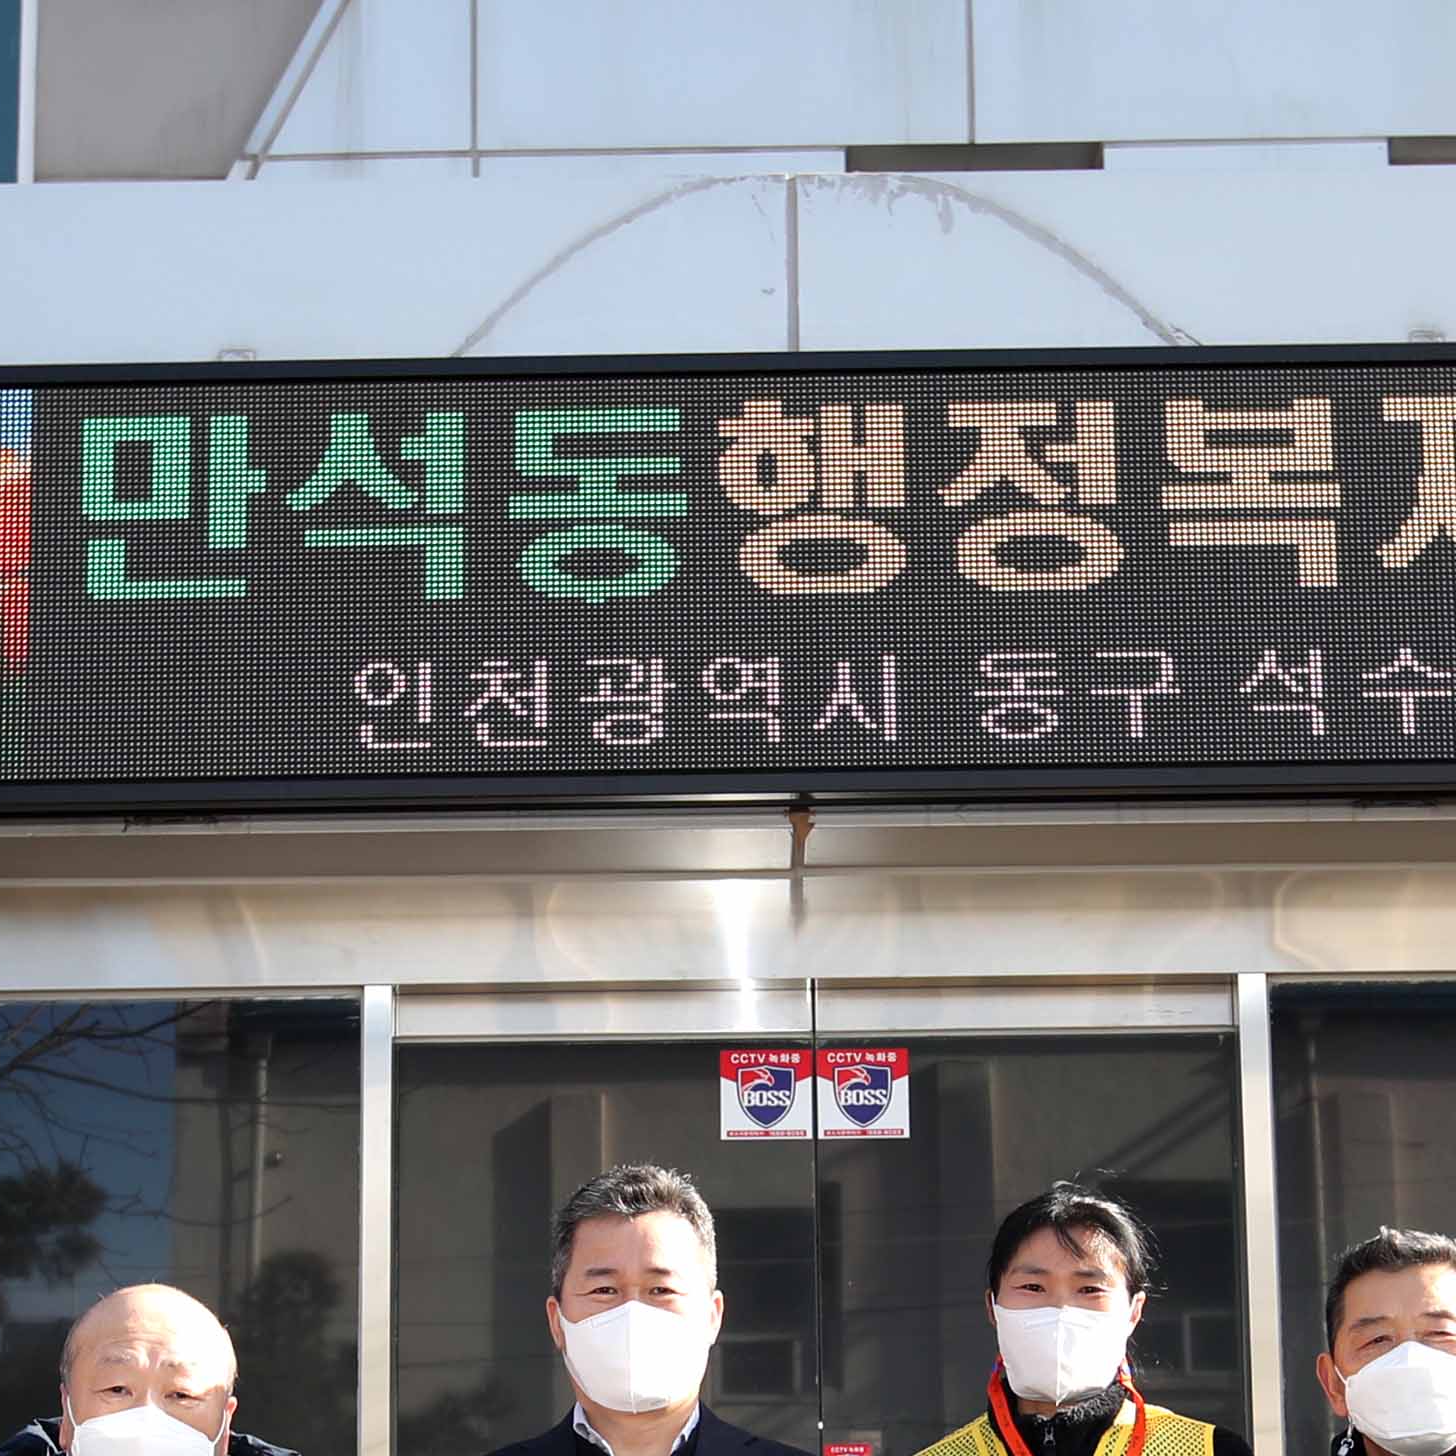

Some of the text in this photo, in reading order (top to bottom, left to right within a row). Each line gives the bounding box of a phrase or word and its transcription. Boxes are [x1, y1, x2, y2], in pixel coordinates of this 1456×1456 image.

[353, 653, 898, 750] 인천광역시
[974, 650, 1181, 740] 동구
[730, 1053, 766, 1064] CCTV
[826, 1052, 862, 1063] CCTV
[744, 1090, 791, 1107] BOSS
[840, 1088, 887, 1106] BOSS
